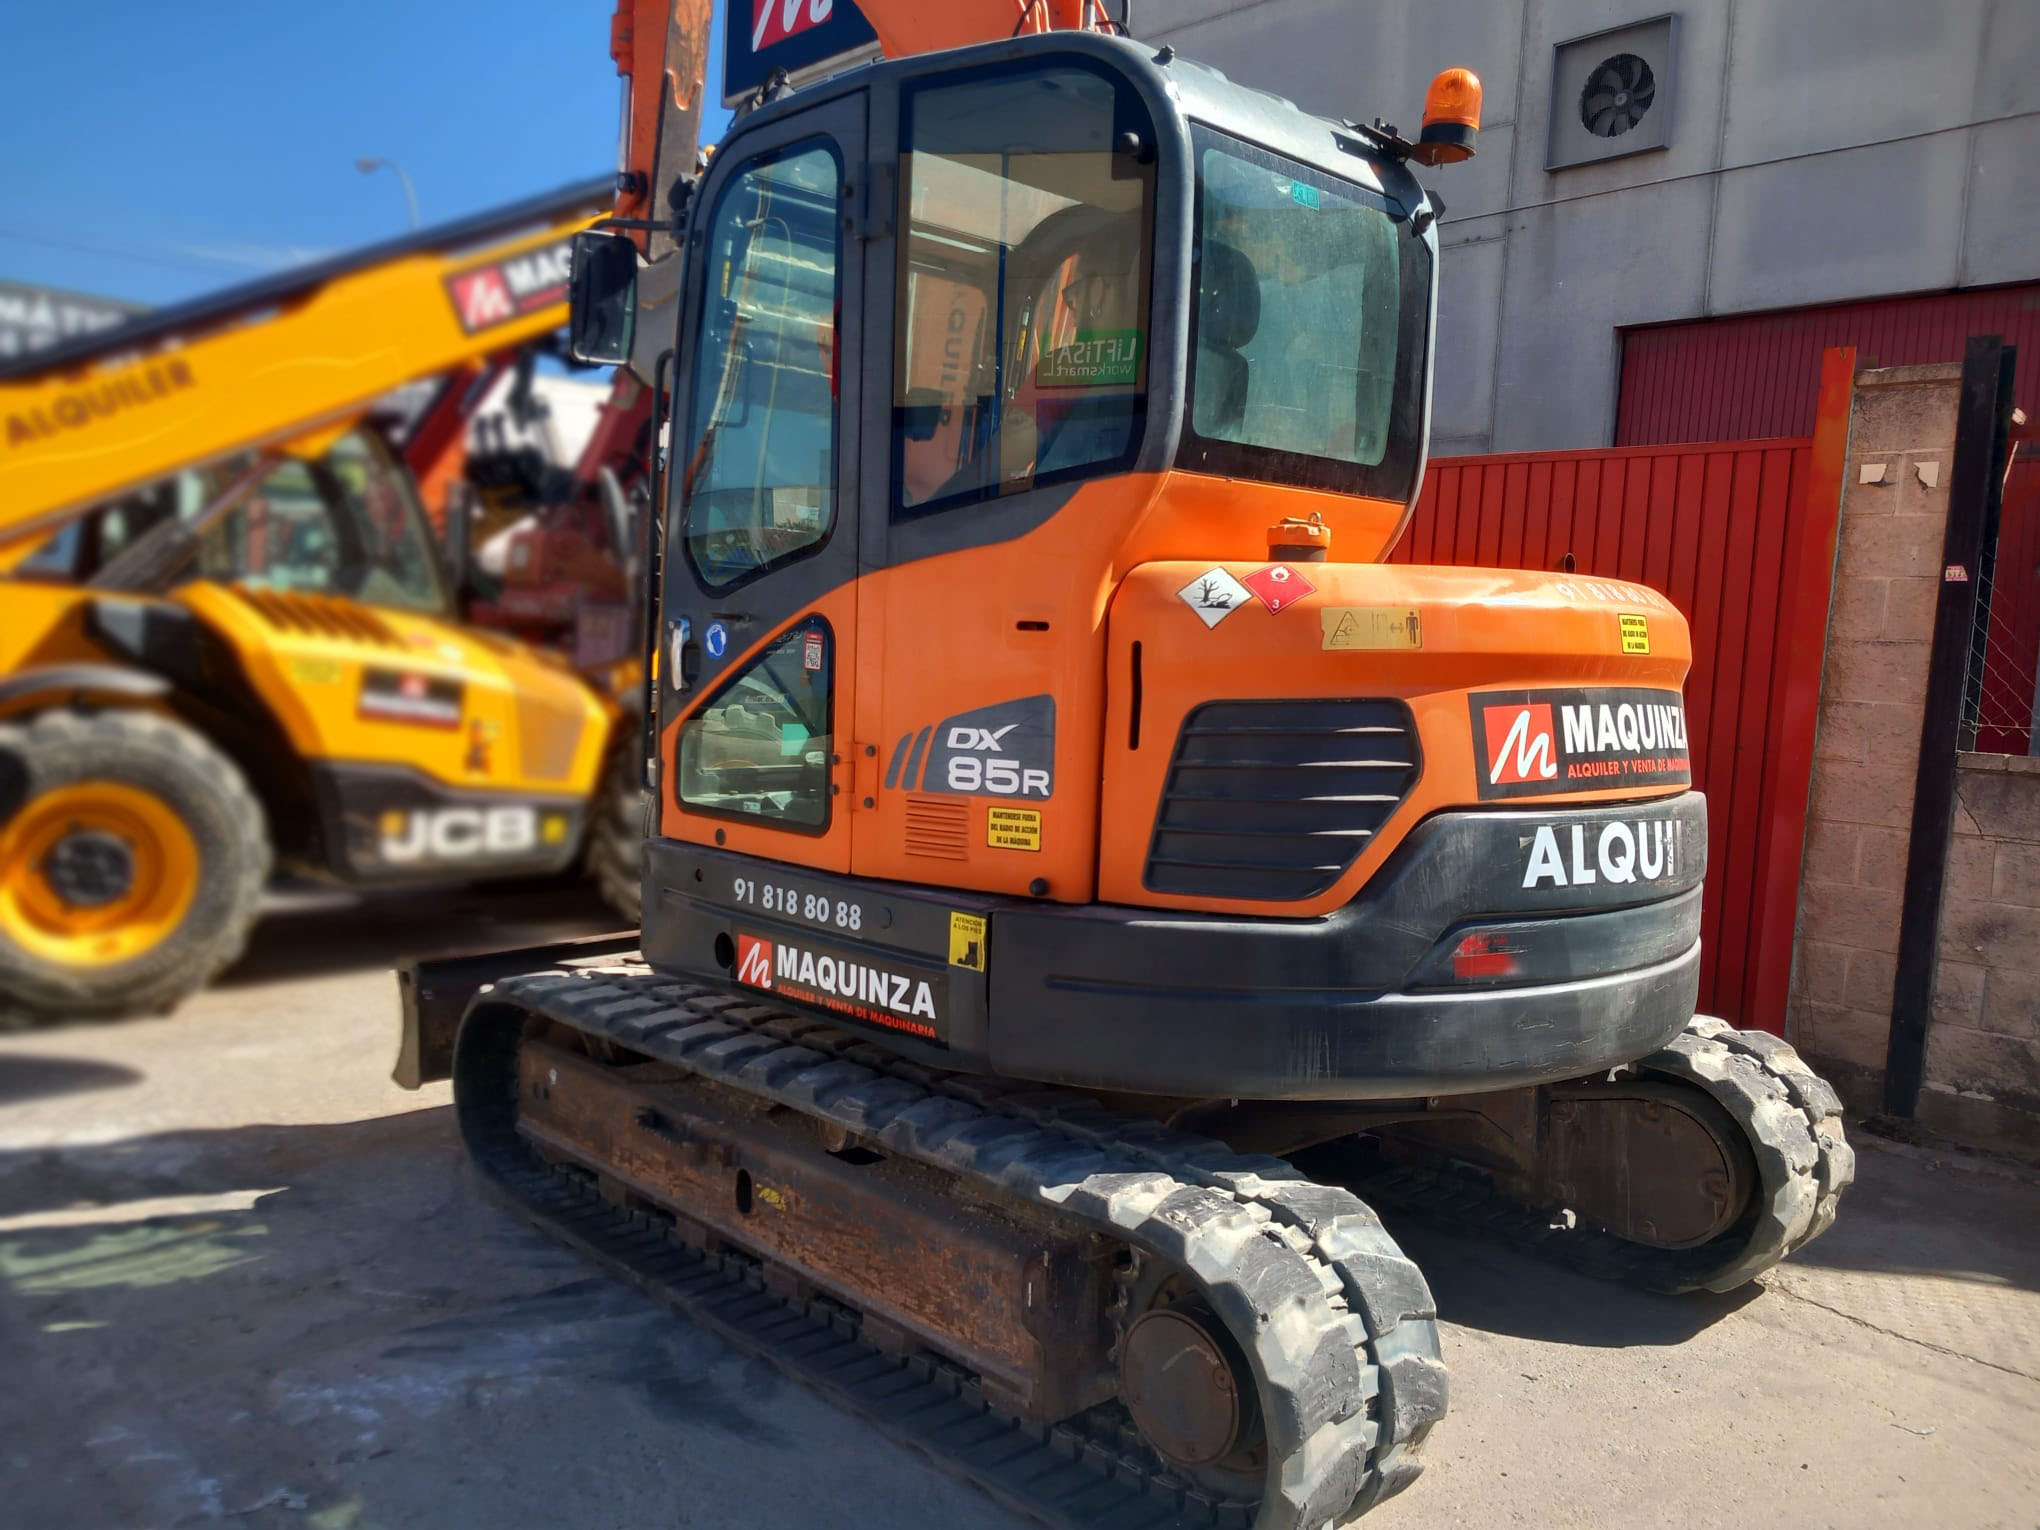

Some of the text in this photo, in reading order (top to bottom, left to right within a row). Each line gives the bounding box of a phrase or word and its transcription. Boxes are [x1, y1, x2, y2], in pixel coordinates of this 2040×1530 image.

[6, 359, 198, 447] ALQUILER
[1271, 599, 1281, 610] 3
[946, 723, 1020, 752] DX
[948, 756, 1050, 797] 85R
[1567, 761, 1621, 779] ALQUILER
[1622, 760, 1629, 775] Y
[1630, 758, 1657, 774] VENTA
[1657, 757, 1667, 772] DE
[381, 807, 536, 864] JCB
[734, 877, 862, 931] 91 818 80 88
[777, 944, 937, 1019] MAQUINZA
[777, 984, 816, 1004] ALQUILER
[826, 998, 854, 1016] VENTA
[855, 1006, 868, 1020] DE
[870, 1010, 937, 1039] MAQUINARIA
